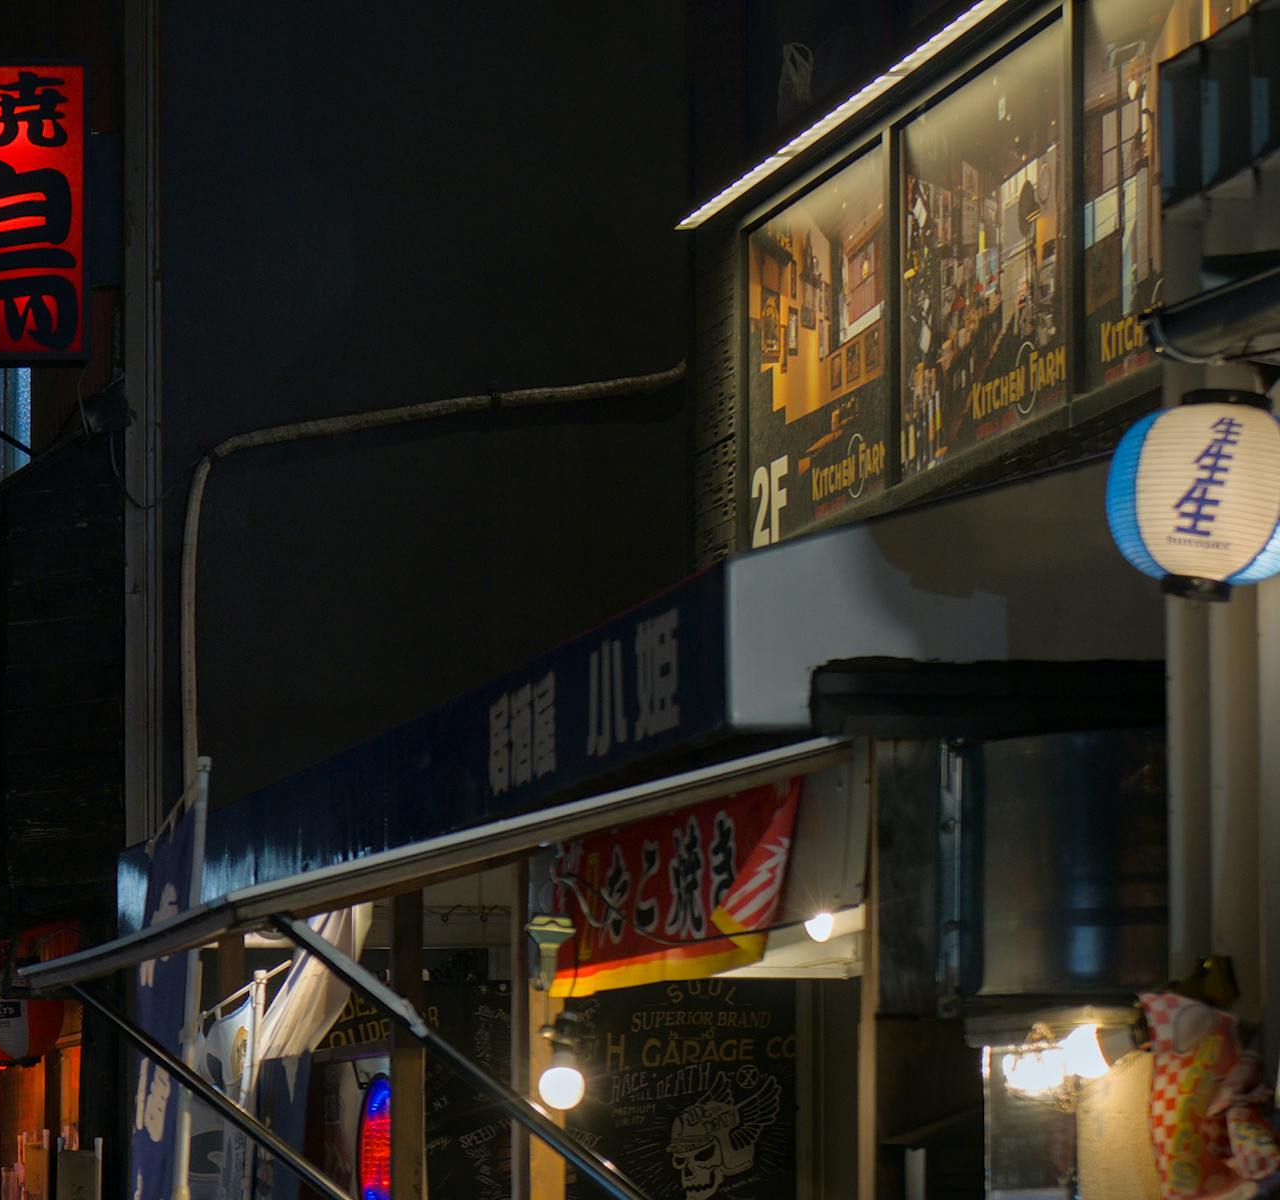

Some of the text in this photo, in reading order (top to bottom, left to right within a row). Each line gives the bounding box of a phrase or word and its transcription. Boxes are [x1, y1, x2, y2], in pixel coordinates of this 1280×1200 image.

[972, 365, 1025, 420] KITCHEN
[1029, 345, 1066, 391] FARM
[751, 455, 788, 548] 2F
[811, 455, 855, 501] KITCHEN
[1174, 416, 1243, 536] 生生生
[631, 1010, 772, 1032] SUPERIOR BRAND
[640, 1037, 755, 1069] GARAGE
